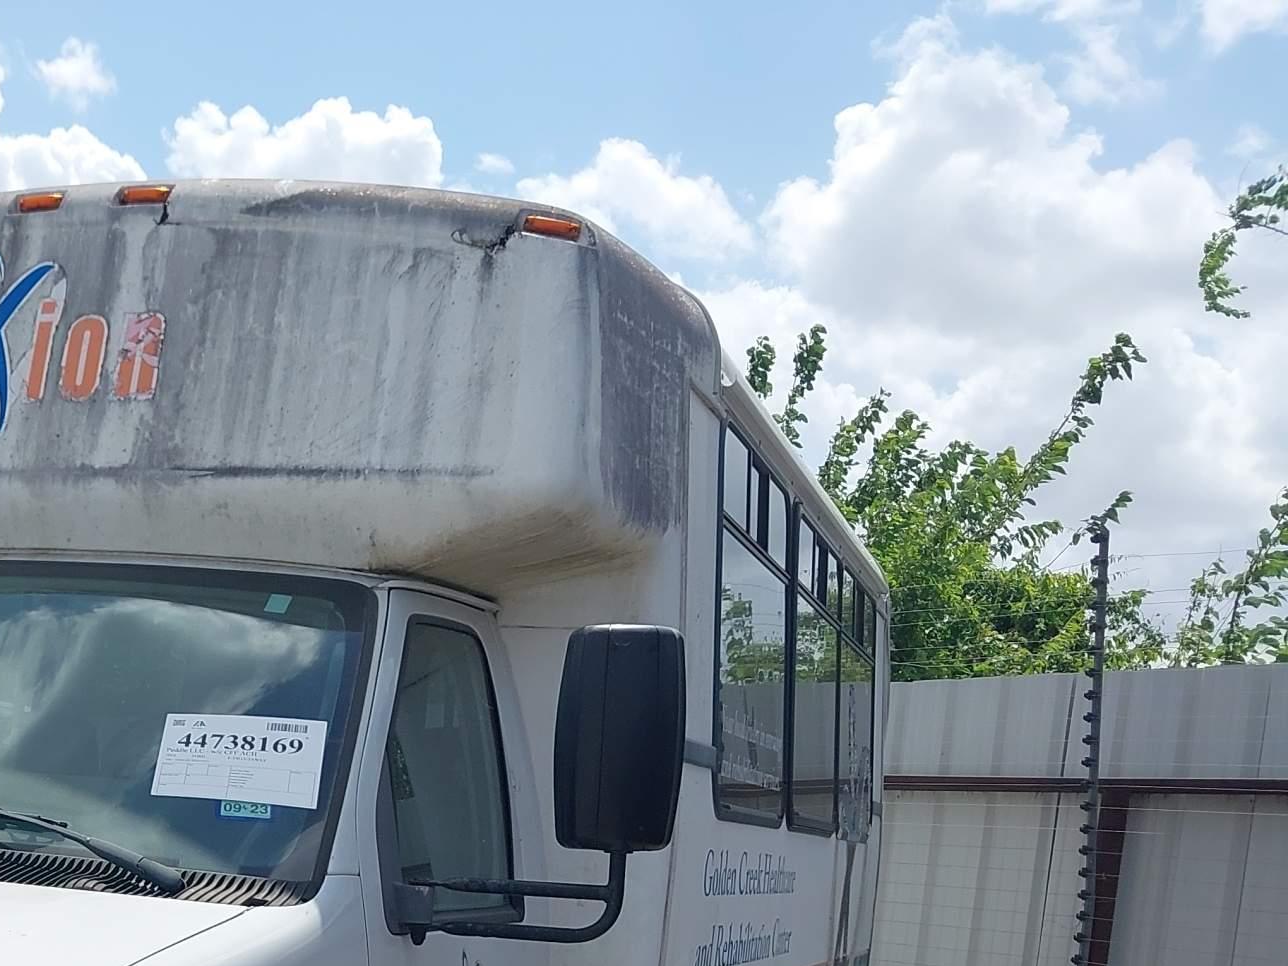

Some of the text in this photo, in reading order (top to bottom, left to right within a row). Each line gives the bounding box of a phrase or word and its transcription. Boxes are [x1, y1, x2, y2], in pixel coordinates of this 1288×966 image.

[177, 733, 304, 754] 44738169
[223, 802, 268, 815] 09 23
[704, 849, 736, 896] Golden
[739, 851, 761, 895] Creek
